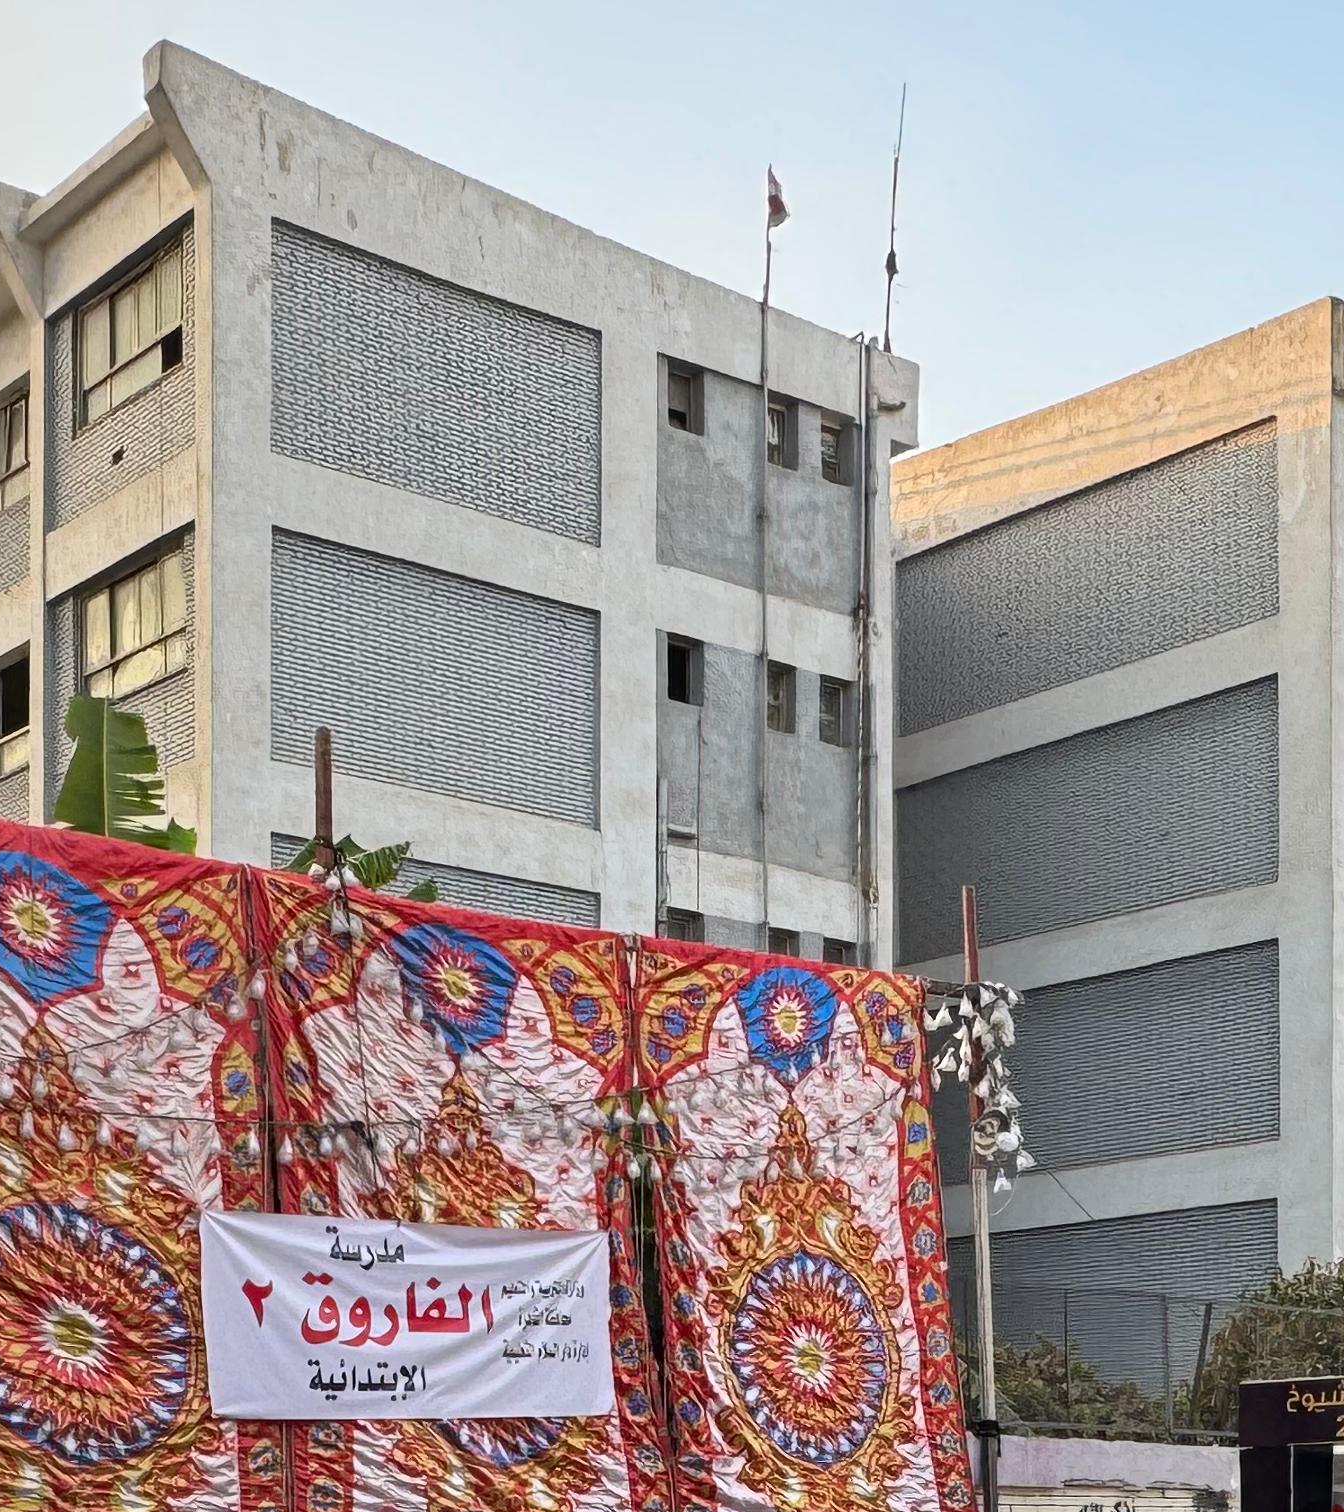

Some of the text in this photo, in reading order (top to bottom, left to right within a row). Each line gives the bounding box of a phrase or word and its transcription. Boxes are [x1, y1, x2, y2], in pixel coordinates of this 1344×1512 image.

[326, 1225, 405, 1271] مدرسة
[241, 1278, 274, 1328] ٢
[300, 1271, 496, 1347] الفاروق
